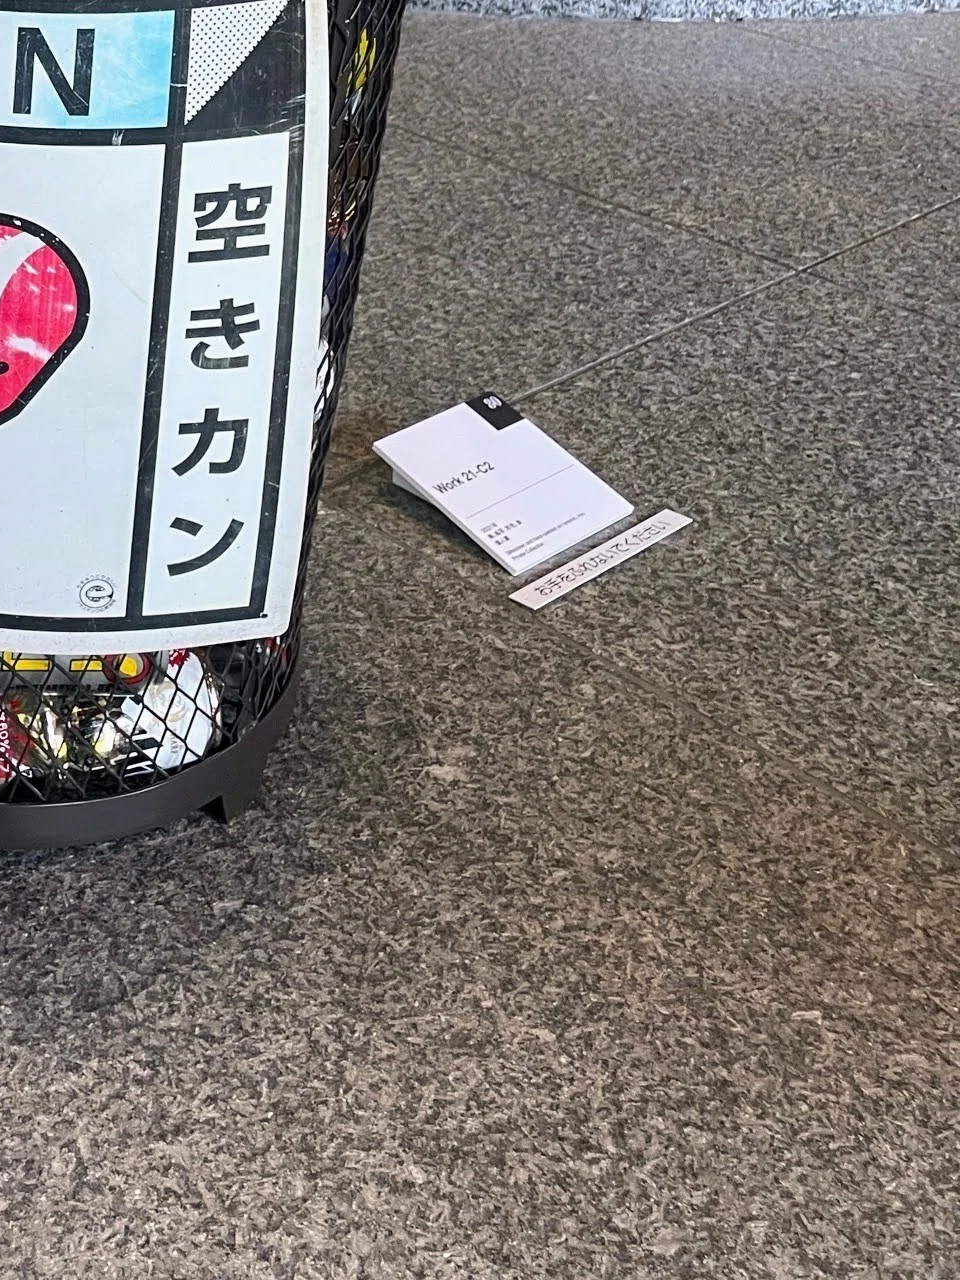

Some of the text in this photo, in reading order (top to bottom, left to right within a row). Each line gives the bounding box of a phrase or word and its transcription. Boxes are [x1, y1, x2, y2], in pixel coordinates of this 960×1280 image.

[164, 182, 273, 577] 空きカン
[432, 460, 495, 495] Work 21-C2
[534, 521, 671, 598] お手をふれないでください
